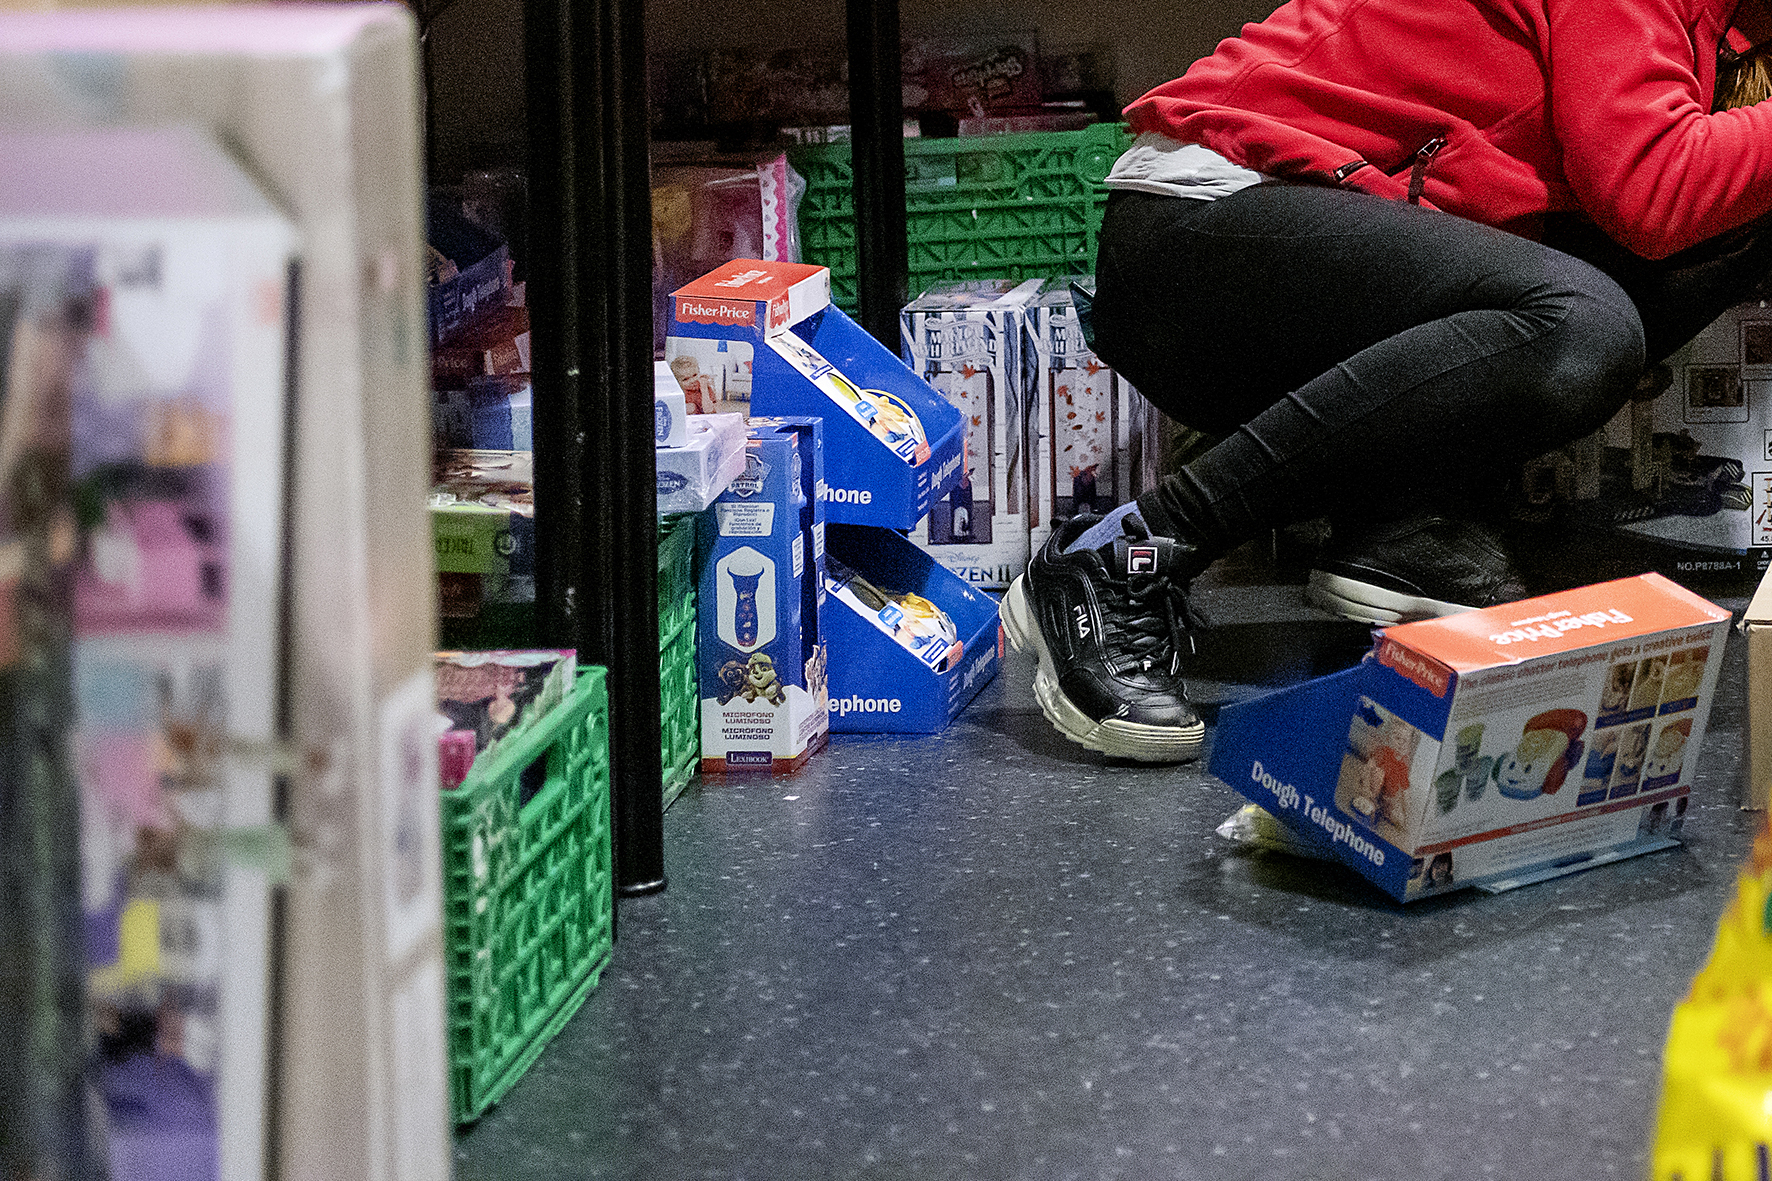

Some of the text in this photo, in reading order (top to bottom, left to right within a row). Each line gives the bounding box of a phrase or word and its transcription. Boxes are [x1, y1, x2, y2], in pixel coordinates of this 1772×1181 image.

[1073, 604, 1091, 639] FILA
[1251, 760, 1386, 866] Dough Telephone
